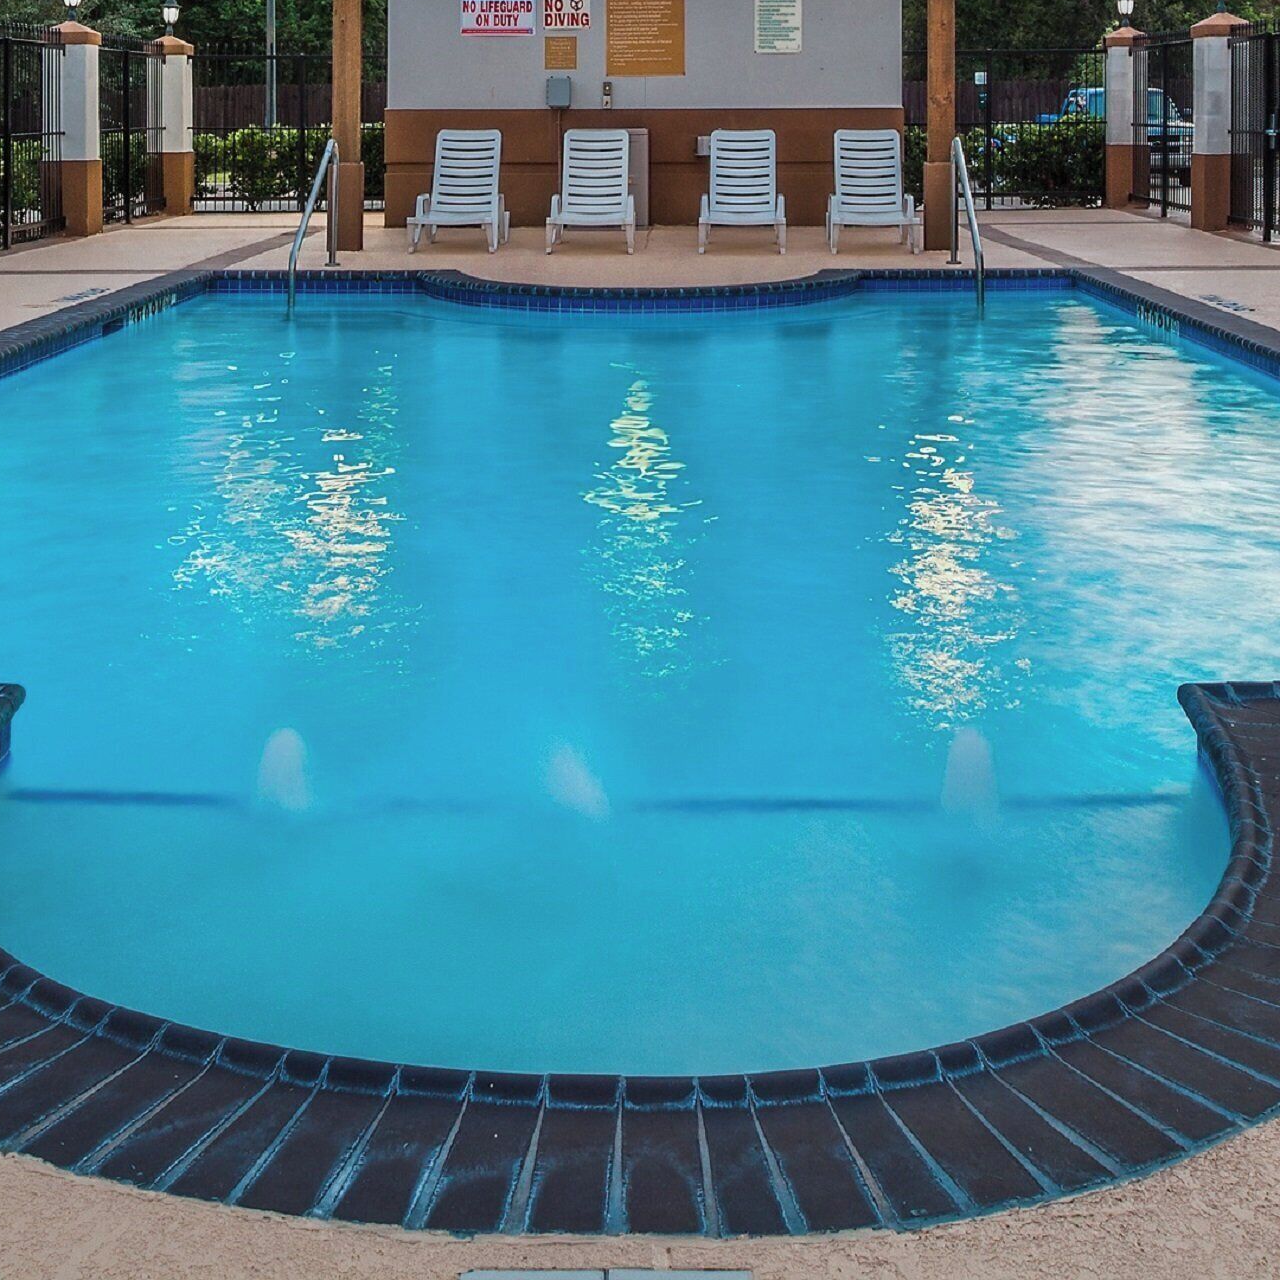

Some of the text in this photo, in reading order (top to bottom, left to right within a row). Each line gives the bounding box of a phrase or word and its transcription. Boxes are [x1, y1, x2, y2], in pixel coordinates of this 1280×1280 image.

[462, 0, 533, 13] NO LIFEGUARD
[475, 14, 519, 27] ON DUTY
[544, 12, 590, 27] DIVING
